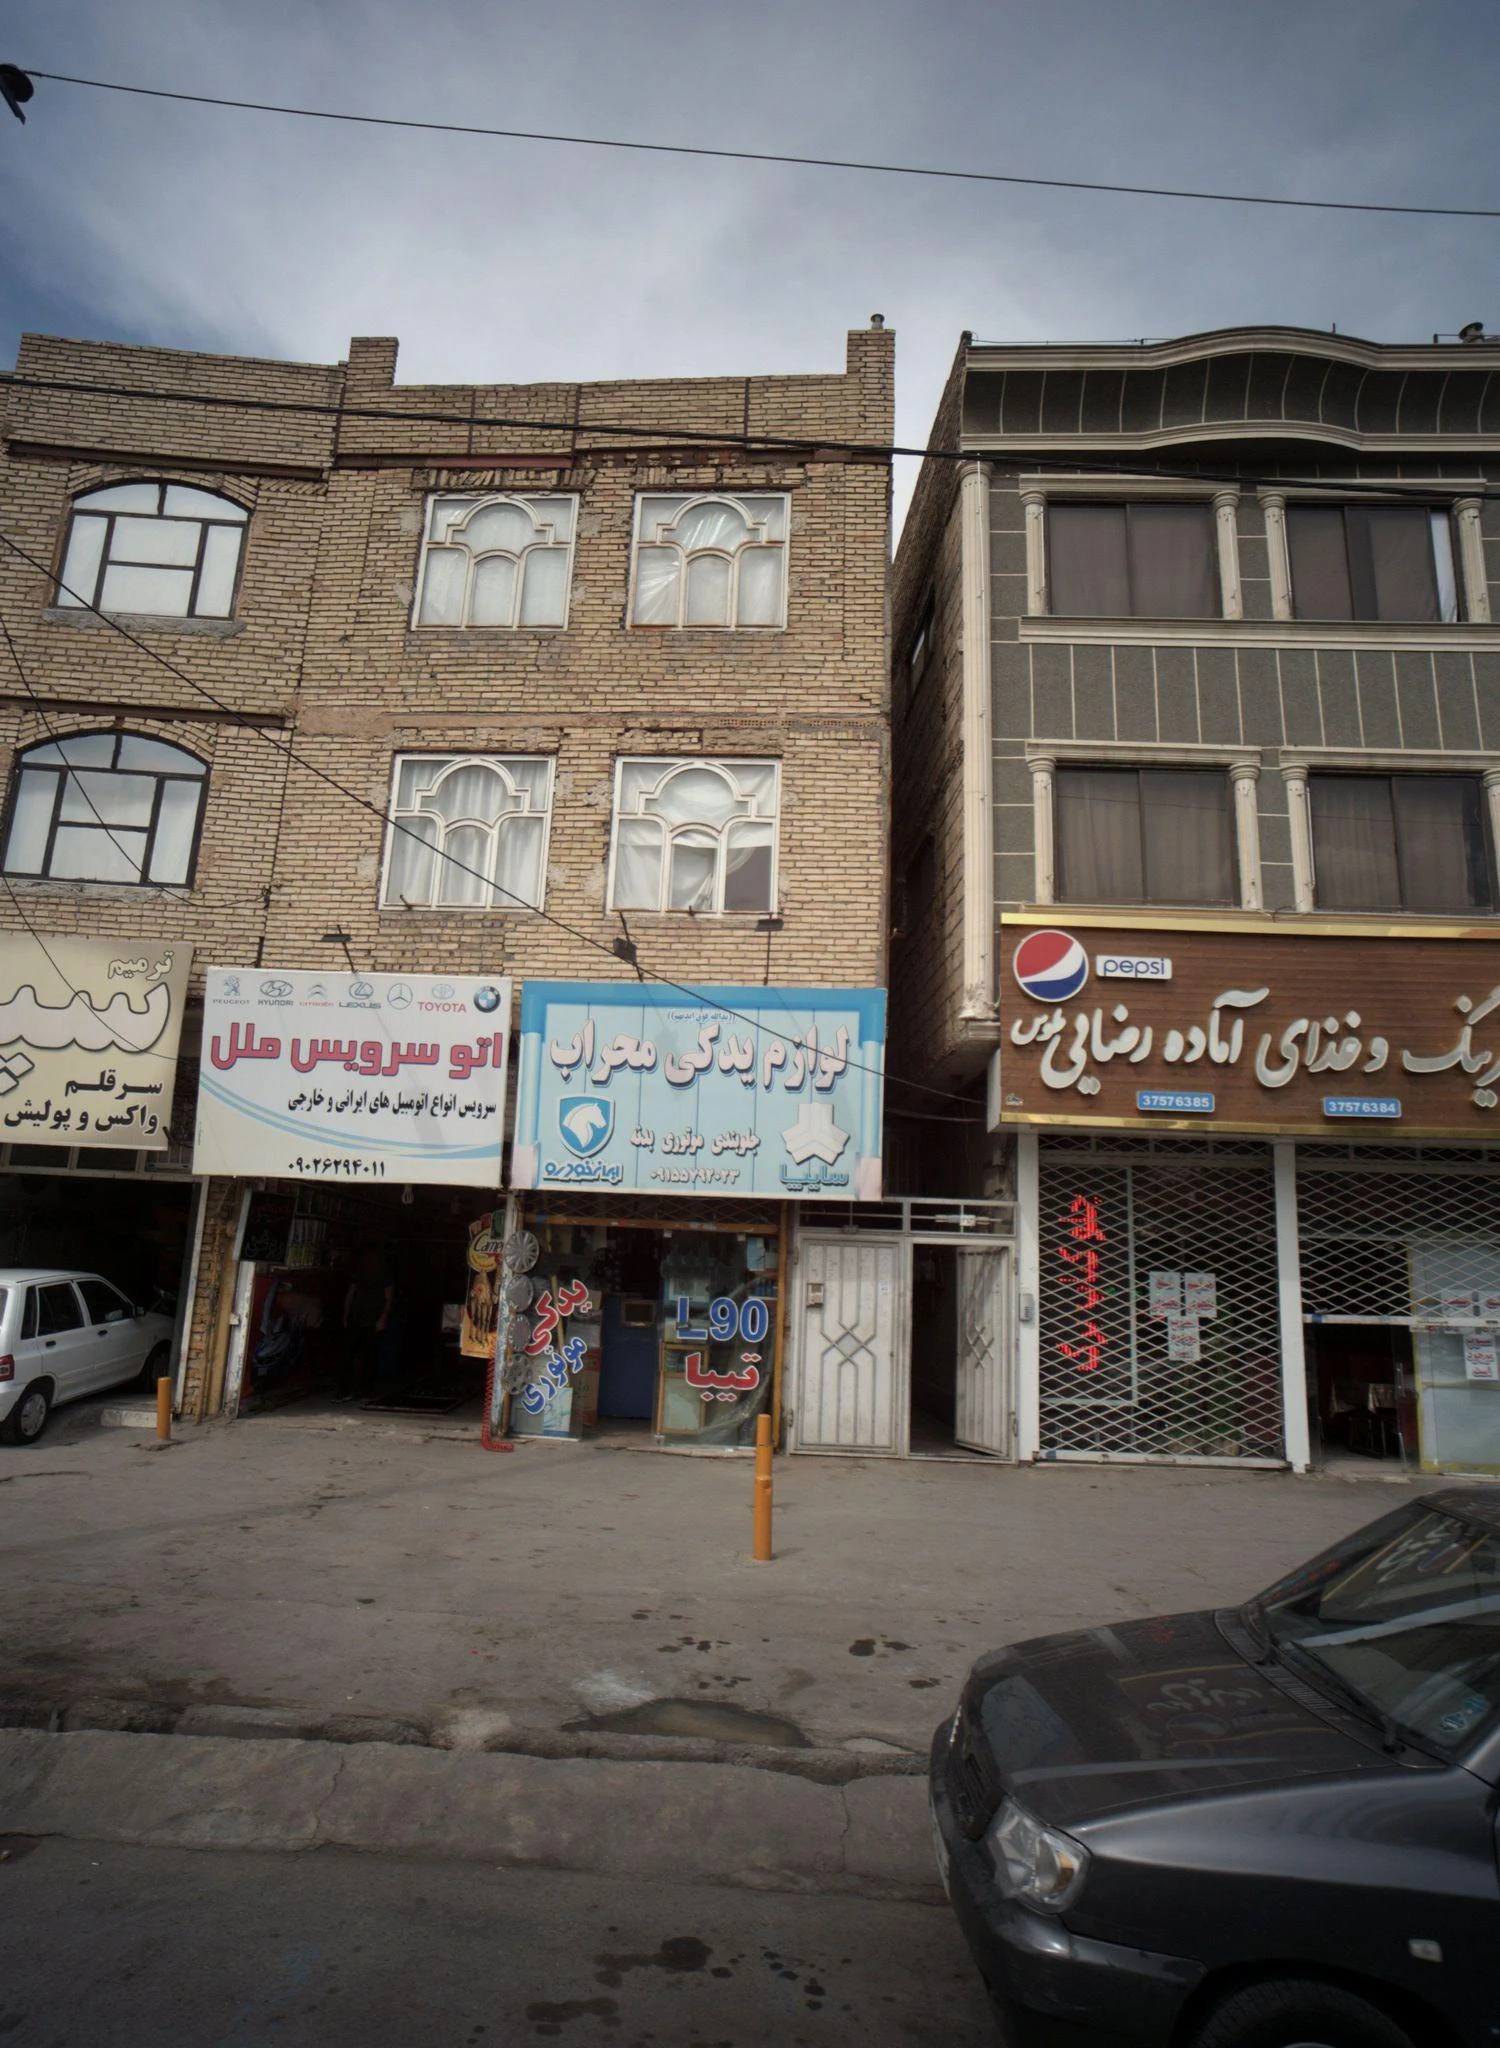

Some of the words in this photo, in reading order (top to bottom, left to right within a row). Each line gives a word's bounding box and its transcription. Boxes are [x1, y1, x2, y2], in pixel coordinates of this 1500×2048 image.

[107, 950, 174, 980] ترمیم
[1103, 957, 1165, 978] pepsi
[258, 1000, 294, 1008] HYUNDAI
[339, 1001, 381, 1010] LEXUS
[418, 1001, 467, 1013] TOYOTA
[1164, 988, 1269, 1064] آماده
[210, 1021, 281, 1071] ملل
[290, 1038, 440, 1076] سرویس
[449, 1032, 502, 1079] اتو
[551, 1018, 658, 1088] محراب
[664, 1023, 756, 1089] یدکی
[764, 1023, 850, 1093] لوازم
[1255, 1010, 1363, 1087] غذای
[1363, 1037, 1389, 1072] و
[288, 1088, 325, 1112] خارجی
[327, 1095, 333, 1112] و
[335, 1089, 367, 1114] ایرانی
[369, 1090, 390, 1114] های
[392, 1091, 429, 1116] اتومبیل
[430, 1094, 457, 1117] انواع
[459, 1101, 497, 1119] سرویس
[1143, 1094, 1210, 1108] 37576385
[1329, 1101, 1396, 1114] 37576384
[4, 1100, 71, 1131] پولیش
[76, 1110, 89, 1131] و
[95, 1104, 159, 1134] واکس
[288, 1157, 385, 1176] ۰۹۰۲۶۲۹۴۰۱۱
[780, 1163, 849, 1192] سایپا
[524, 1279, 592, 1356] یدکی
[522, 1336, 587, 1414] موتوری
[685, 1352, 762, 1401] تیبا
